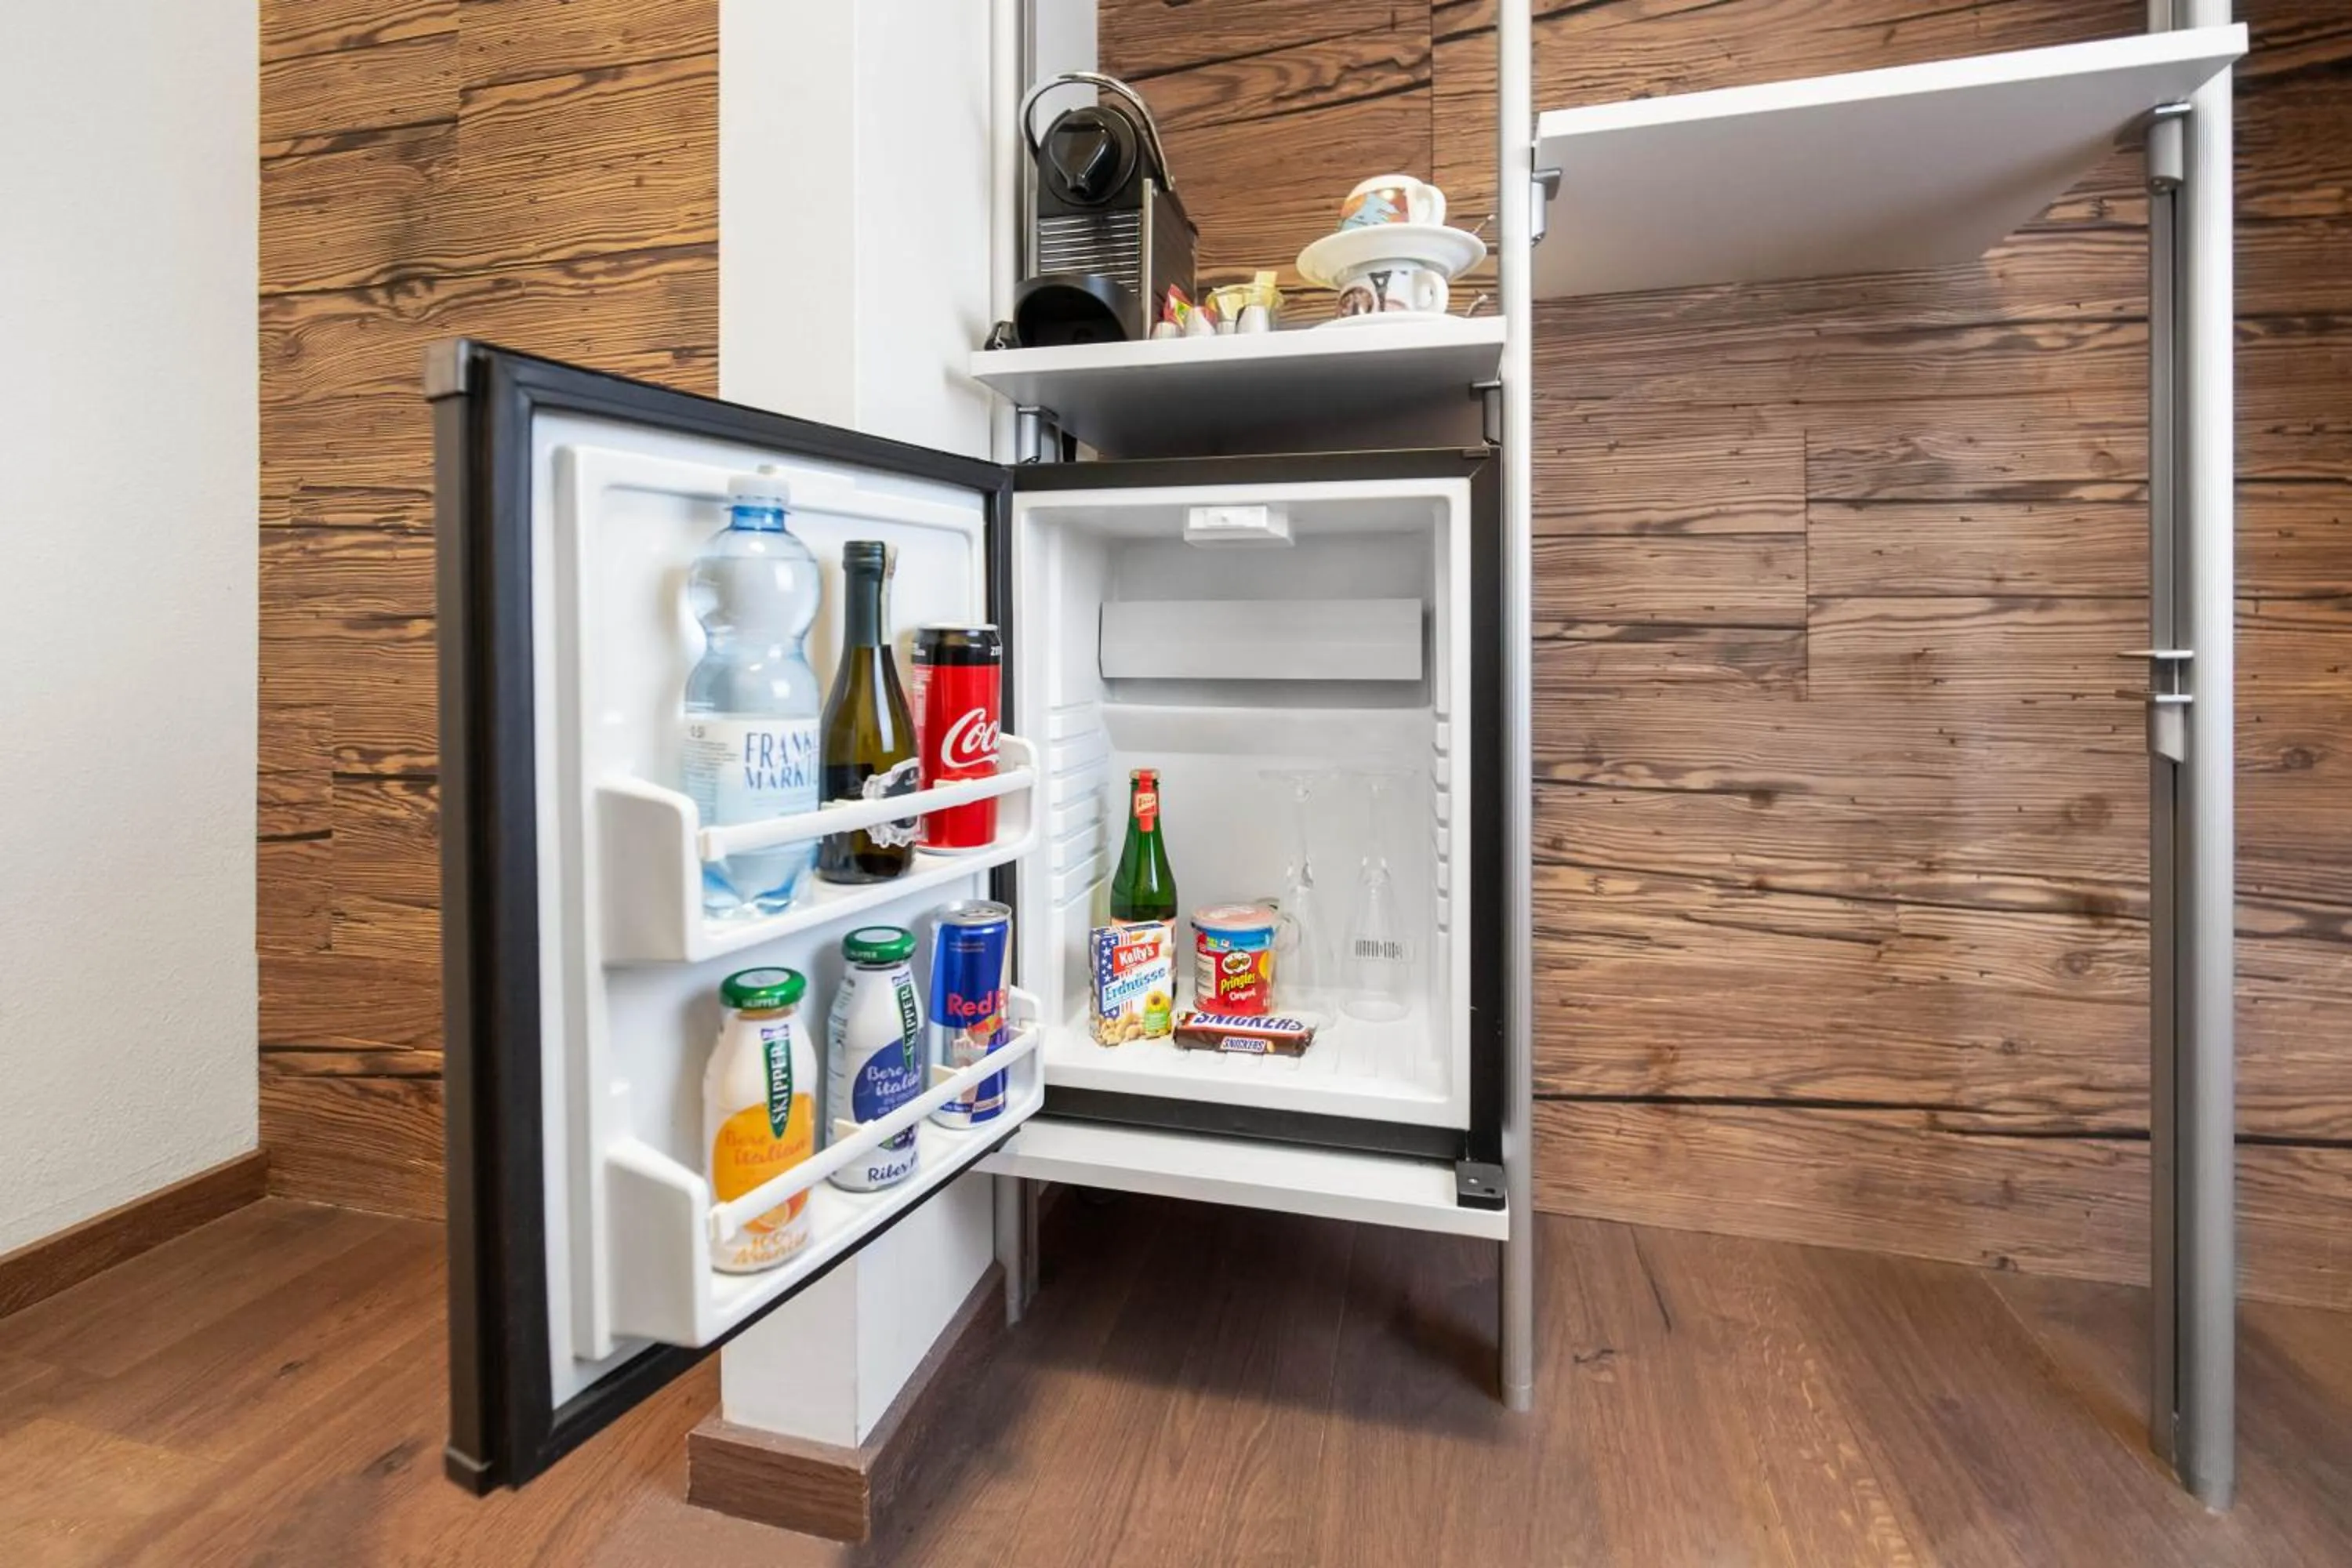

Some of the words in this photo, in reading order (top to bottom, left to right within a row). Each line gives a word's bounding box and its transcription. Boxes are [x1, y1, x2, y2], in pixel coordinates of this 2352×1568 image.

[1119, 945, 1155, 966] Kelly's
[1105, 967, 1166, 1000] Erdnüsse
[948, 991, 993, 1015] Red
[902, 987, 916, 1056] SKIPPER
[1193, 1012, 1305, 1031] SNICKERS
[1222, 1038, 1265, 1051] SNICKERS
[771, 1043, 789, 1124] SKIPPER
[867, 1065, 905, 1082] Bere
